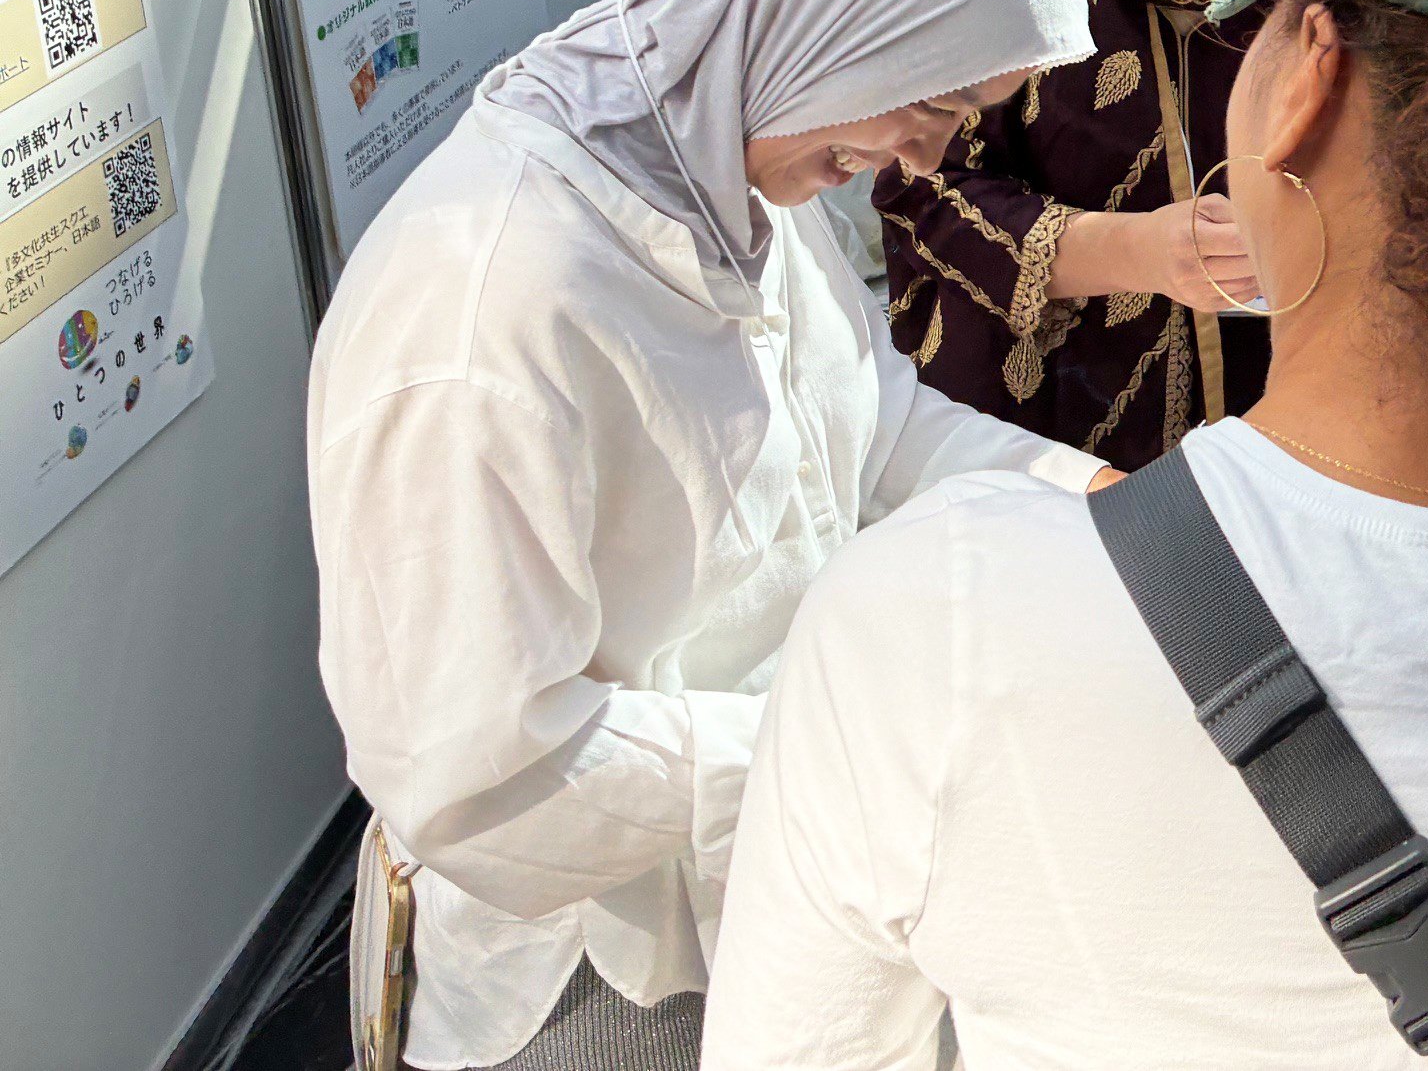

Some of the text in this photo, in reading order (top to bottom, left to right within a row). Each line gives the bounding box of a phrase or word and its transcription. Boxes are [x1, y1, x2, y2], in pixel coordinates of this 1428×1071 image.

[1, 101, 89, 169] の情報サイト
[7, 103, 134, 199] を提供しています！
[4, 214, 101, 295] 企業セミナー、日本語
[105, 250, 152, 294] つなげる
[109, 270, 157, 316] ひろげる
[53, 315, 166, 421] ひとつの世界
